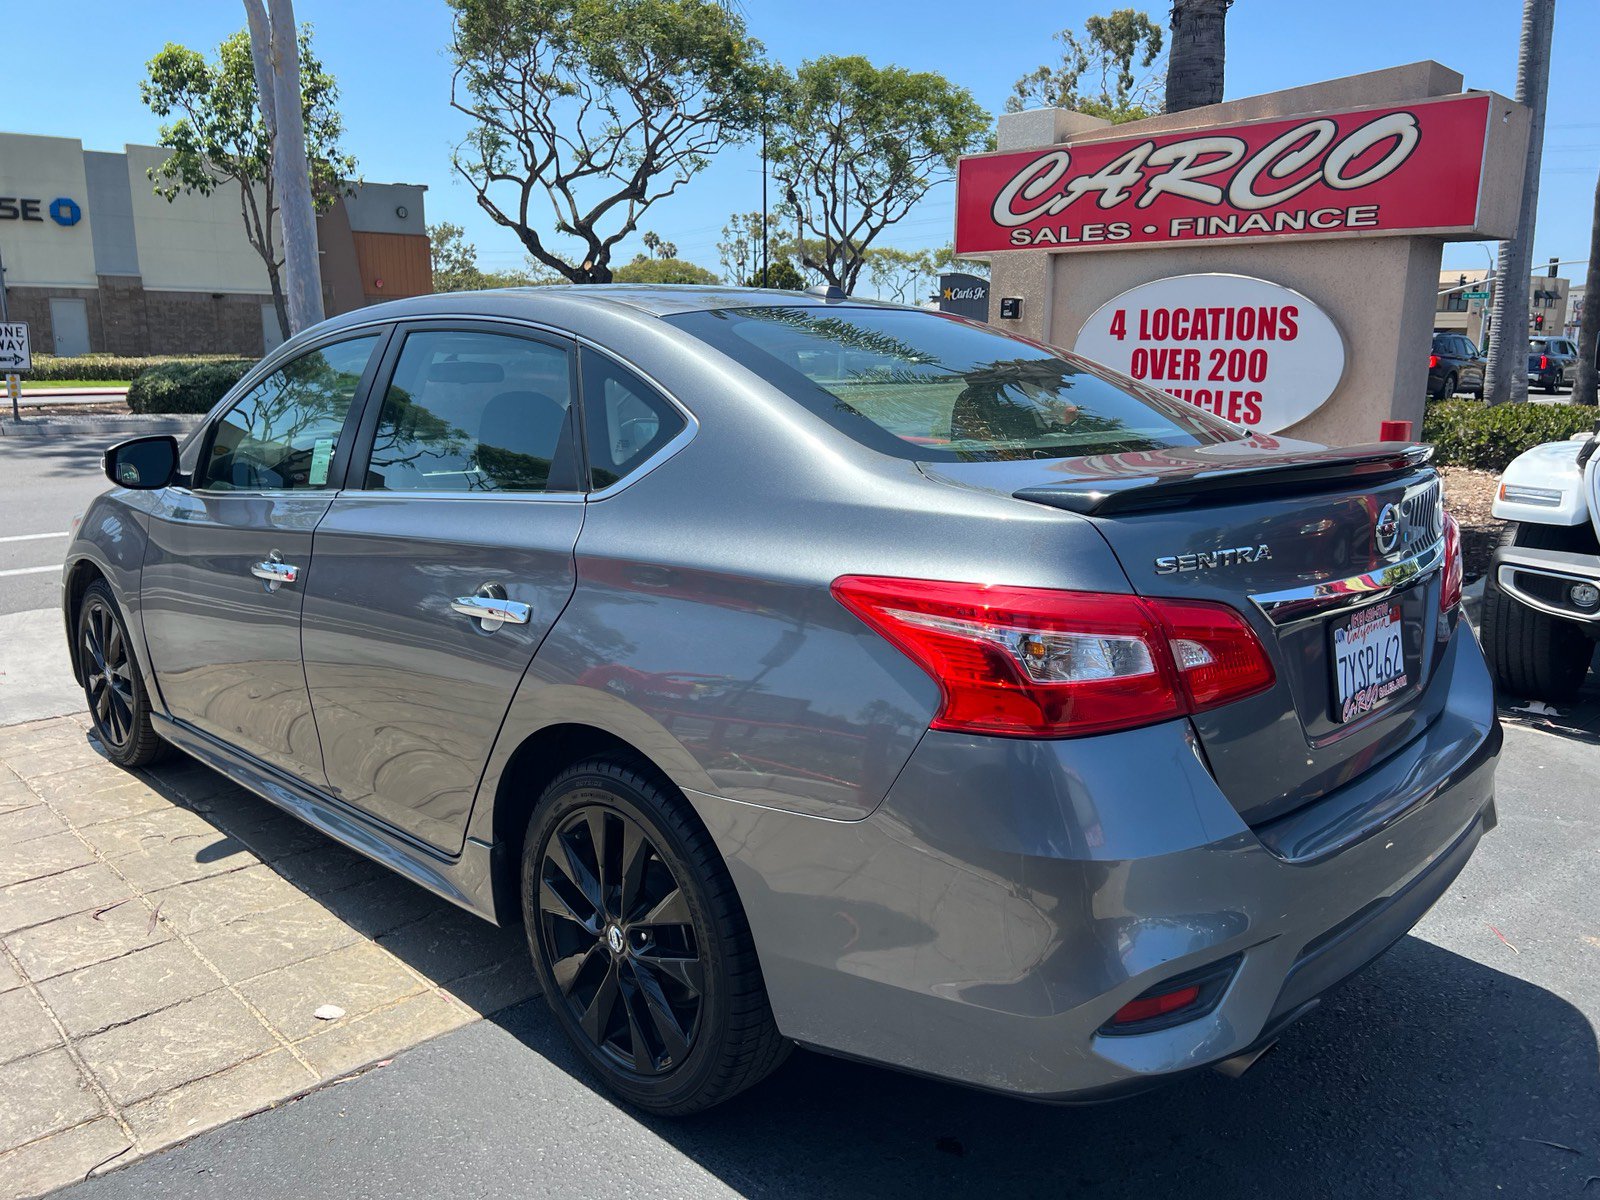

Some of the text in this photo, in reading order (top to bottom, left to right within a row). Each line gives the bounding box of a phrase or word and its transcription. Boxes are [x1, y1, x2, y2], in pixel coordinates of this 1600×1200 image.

[991, 111, 1422, 227] CARCO
[1010, 205, 1380, 246] SALES FINANCE
[0, 327, 24, 338] NE
[1109, 306, 1299, 341] 4 LOCATIONS
[1131, 348, 1268, 382] OVER 200
[1154, 544, 1273, 575] SENTRA
[1338, 635, 1401, 698] 7YSP462
